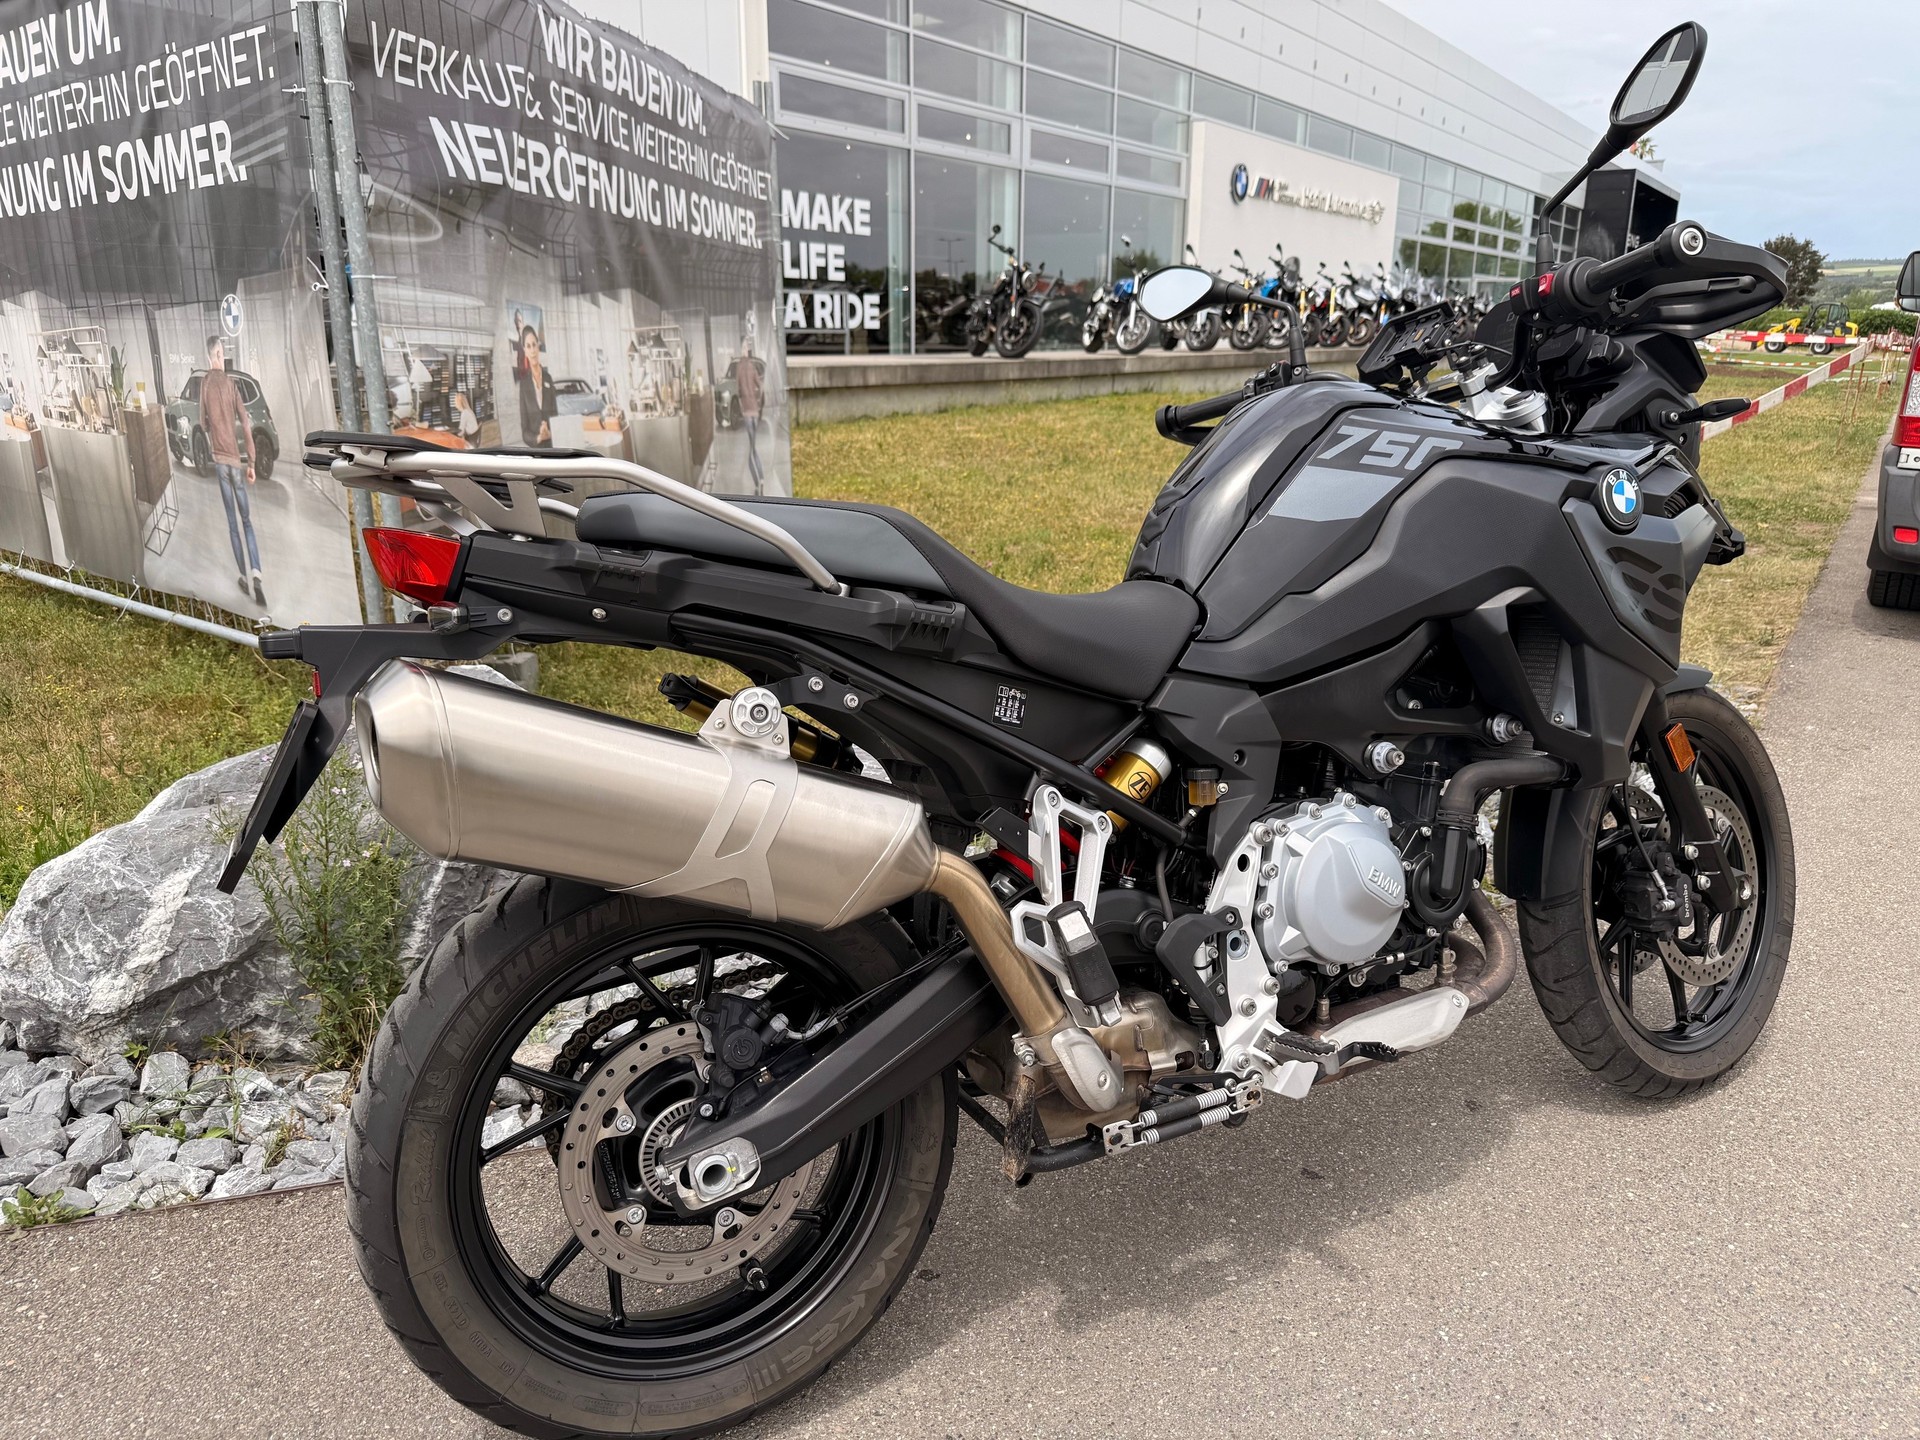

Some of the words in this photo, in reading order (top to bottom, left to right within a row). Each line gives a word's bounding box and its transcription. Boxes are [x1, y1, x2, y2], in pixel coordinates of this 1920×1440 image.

[65, 0, 121, 65] UM.
[16, 70, 131, 141] WEITERHIN
[135, 25, 274, 113] GEÖFFNET.
[371, 20, 525, 110] VERKAUF
[524, 72, 544, 120] &
[550, 80, 630, 152] SERVICE
[631, 116, 709, 182] WEITERHIN
[537, 4, 596, 84] WIR
[600, 36, 673, 120] BAUEN
[676, 80, 707, 137] UM.
[62, 149, 98, 208] IM
[98, 119, 248, 203] SOMMER.
[663, 182, 688, 232] IM
[690, 190, 763, 249] SOMMER.
[781, 188, 871, 236] MAKE
[782, 239, 846, 282] LIFE
[784, 291, 807, 329] A
[813, 293, 881, 330] RIDE
[1608, 471, 1639, 491] BMW
[1129, 772, 1152, 800] ZF
[1367, 865, 1402, 899] BMW
[442, 897, 622, 1065] MICHELIN
